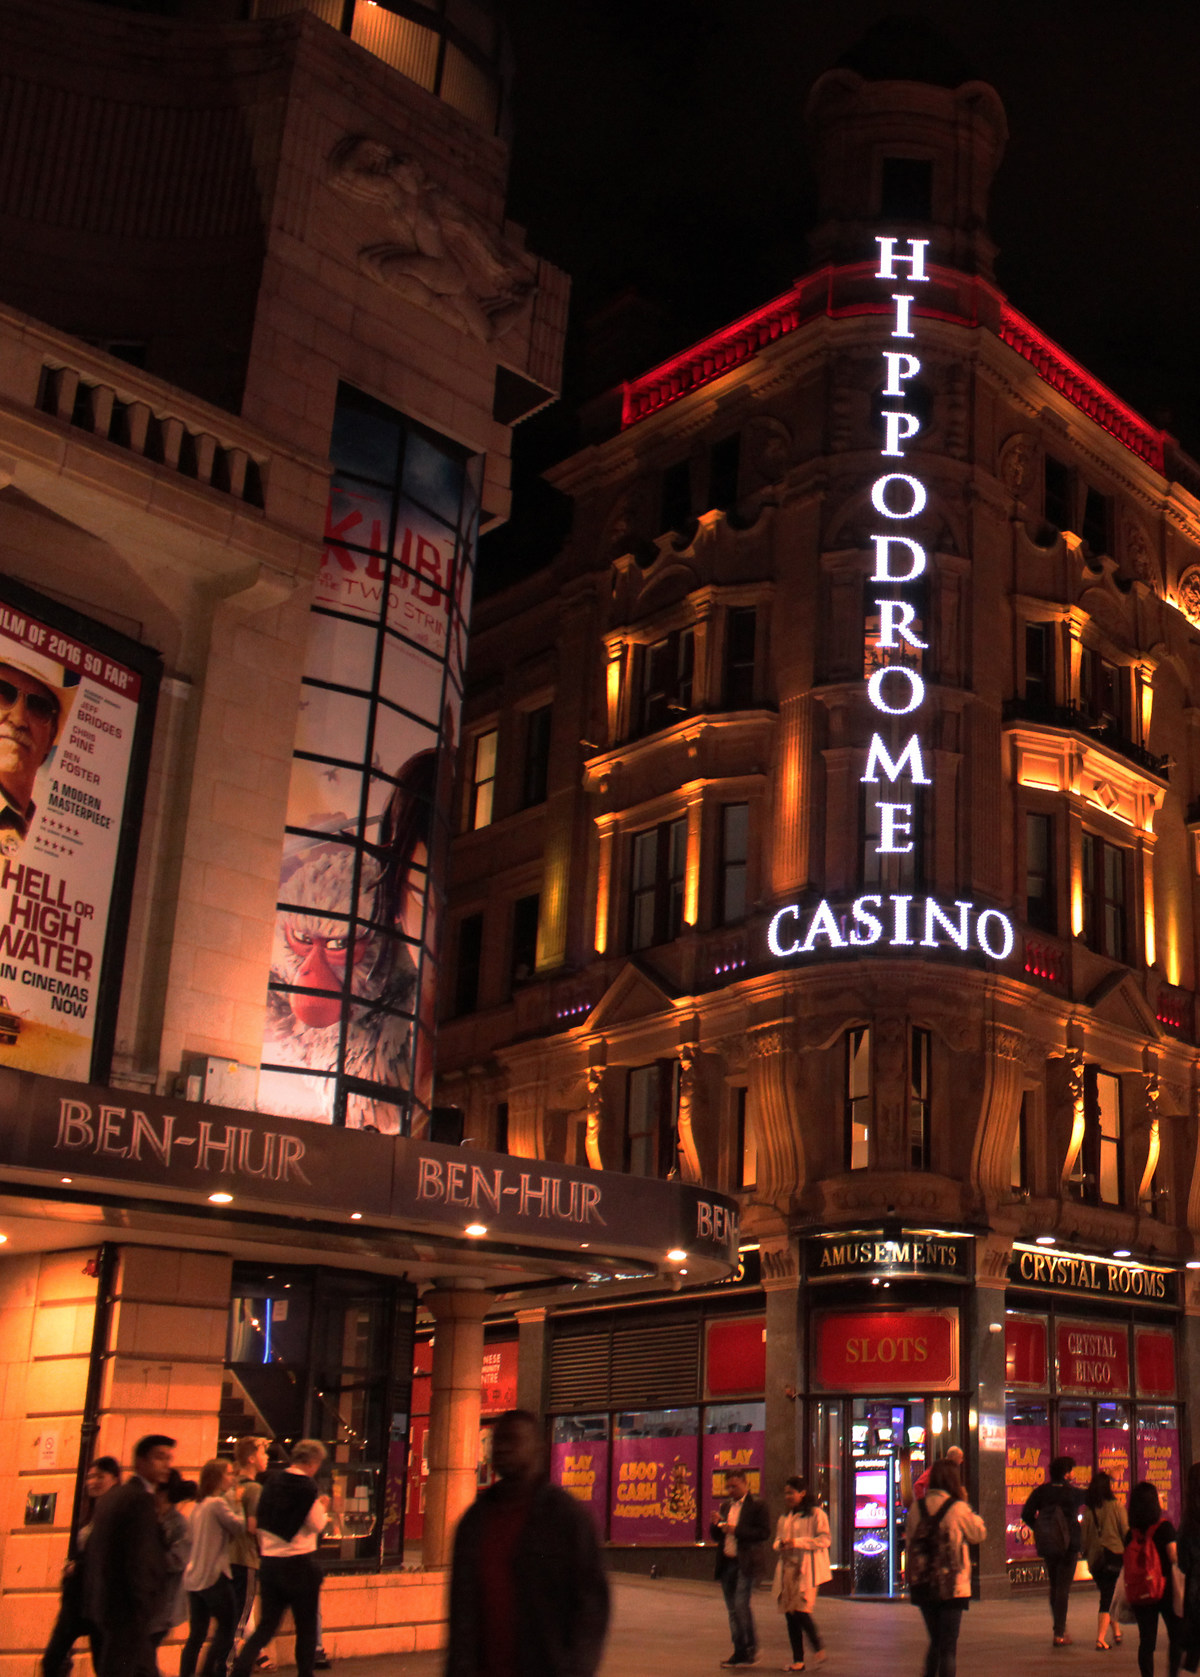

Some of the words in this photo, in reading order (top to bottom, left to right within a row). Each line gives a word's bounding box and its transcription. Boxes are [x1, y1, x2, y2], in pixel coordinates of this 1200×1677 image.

[859, 236, 932, 854] HIPPODROME
[28, 624, 46, 646] OF
[48, 635, 81, 666] 2016
[83, 652, 103, 676] SO
[80, 701, 98, 714] JEFF
[72, 725, 96, 743] CHRIS
[77, 709, 122, 740] BRIDGES
[63, 749, 81, 764] BEN
[69, 734, 95, 755] PINE
[60, 759, 101, 786] FOSTER
[61, 783, 102, 811] MODERN
[1, 858, 72, 912] HELL
[74, 900, 94, 921] OR
[9, 894, 82, 947] HIGH
[767, 895, 1014, 960] CASINO
[0, 962, 17, 981] IN
[21, 969, 90, 1003] CINEMAS
[51, 996, 88, 1019] NOW
[54, 1098, 313, 1187] BEN-HUR
[416, 1157, 608, 1227] BEN-HUR
[820, 1241, 958, 1268] AMUSEMENTS
[1020, 1252, 1101, 1290] CRYSTAL
[1107, 1265, 1166, 1298] ROOMS
[846, 1337, 929, 1364] SLOTS
[1068, 1332, 1117, 1359] CRYSTAL
[1075, 1360, 1111, 1384] BINGO
[564, 1455, 593, 1471] PLAY
[718, 1449, 753, 1466] PLAY
[1007, 1448, 1041, 1467] PLAY
[1005, 1466, 1046, 1486] BINGO
[617, 1482, 658, 1502] CASH
